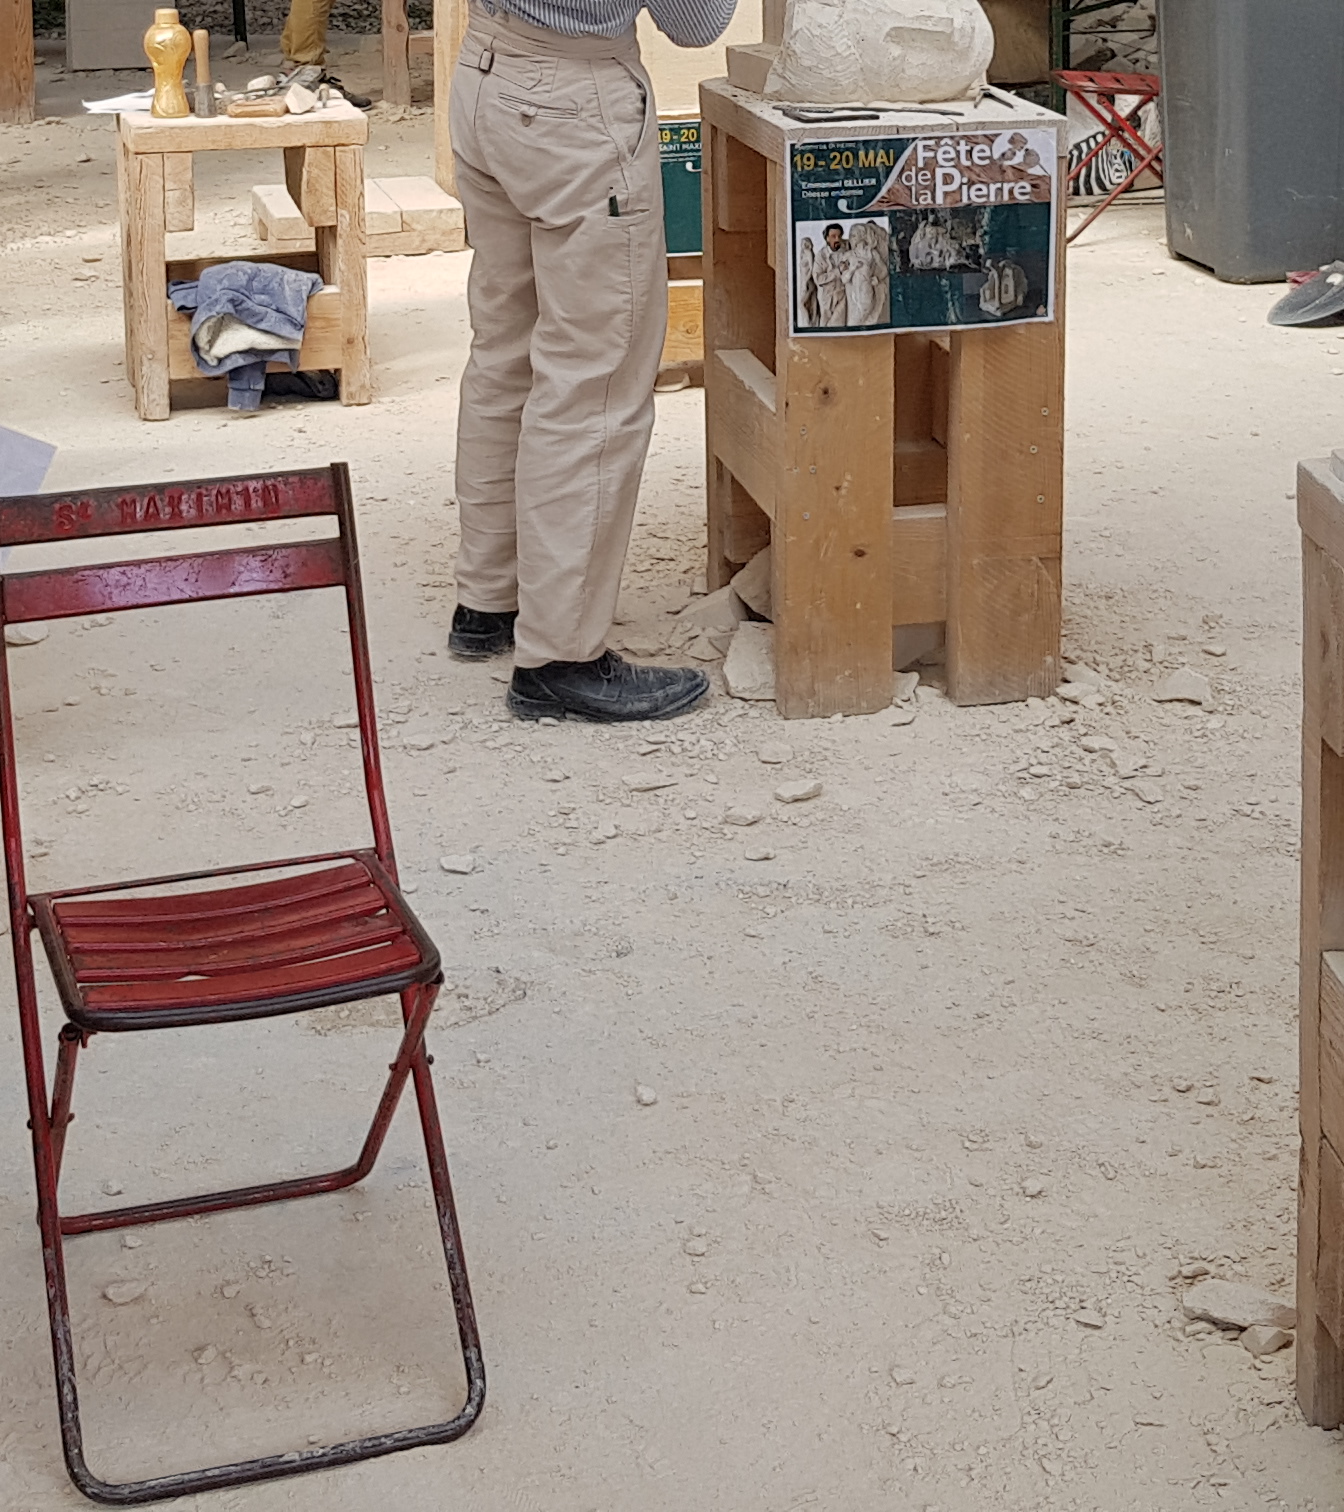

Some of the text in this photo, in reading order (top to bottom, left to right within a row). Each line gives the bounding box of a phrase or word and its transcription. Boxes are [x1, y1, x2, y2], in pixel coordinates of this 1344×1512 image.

[680, 129, 698, 142] 20
[793, 152, 815, 172] 19
[829, 150, 854, 170] 20
[858, 148, 894, 168] MAI
[916, 138, 991, 168] Fête
[901, 166, 931, 186] de
[935, 167, 1032, 205] Pierre
[911, 186, 933, 205] la
